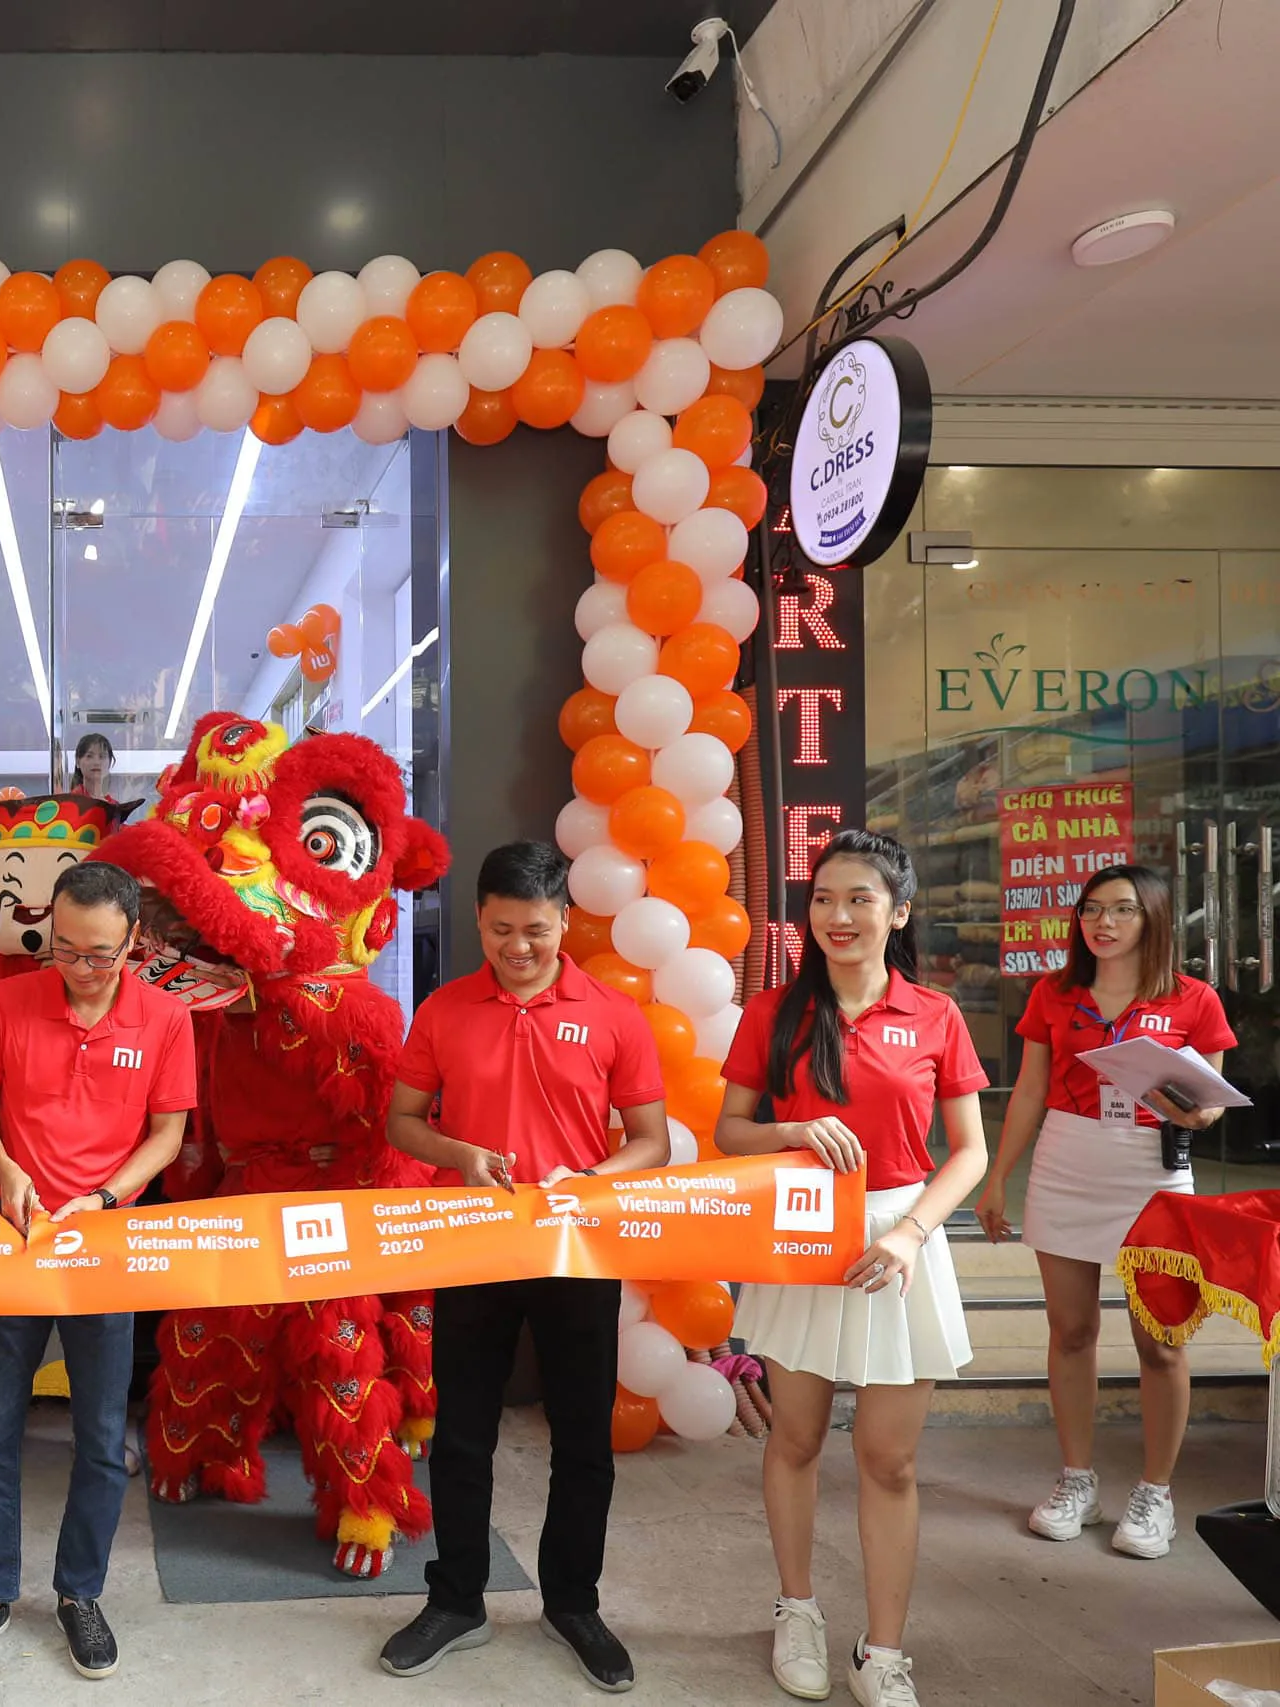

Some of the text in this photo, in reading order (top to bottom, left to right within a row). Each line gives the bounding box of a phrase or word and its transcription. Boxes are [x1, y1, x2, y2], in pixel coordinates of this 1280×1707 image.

[810, 431, 874, 491] C.DRESS
[936, 668, 1209, 712] EVERON
[1064, 784, 1125, 806] THUÊ
[1012, 815, 1048, 842] CẢ
[1057, 813, 1121, 839] NHÀ
[1010, 853, 1065, 880] DIỆN
[1072, 850, 1127, 872] TÍCH
[1045, 886, 1053, 907] 1
[1004, 920, 1034, 942] LH:
[667, 1173, 737, 1194] Opening
[373, 1195, 495, 1217] Grand Opening
[616, 1195, 752, 1217] Vietnam MiStore
[126, 1215, 244, 1233] Grand Opening
[376, 1209, 514, 1236] Vietnam MiStore
[620, 1219, 662, 1239] 2020
[126, 1235, 261, 1251] Vietnam MiStore
[379, 1238, 424, 1256] 2020
[772, 1241, 833, 1256] xiaomi
[36, 1256, 101, 1269] DIGIWORLD
[126, 1256, 170, 1273] 2020
[287, 1259, 351, 1278] xiaomi
